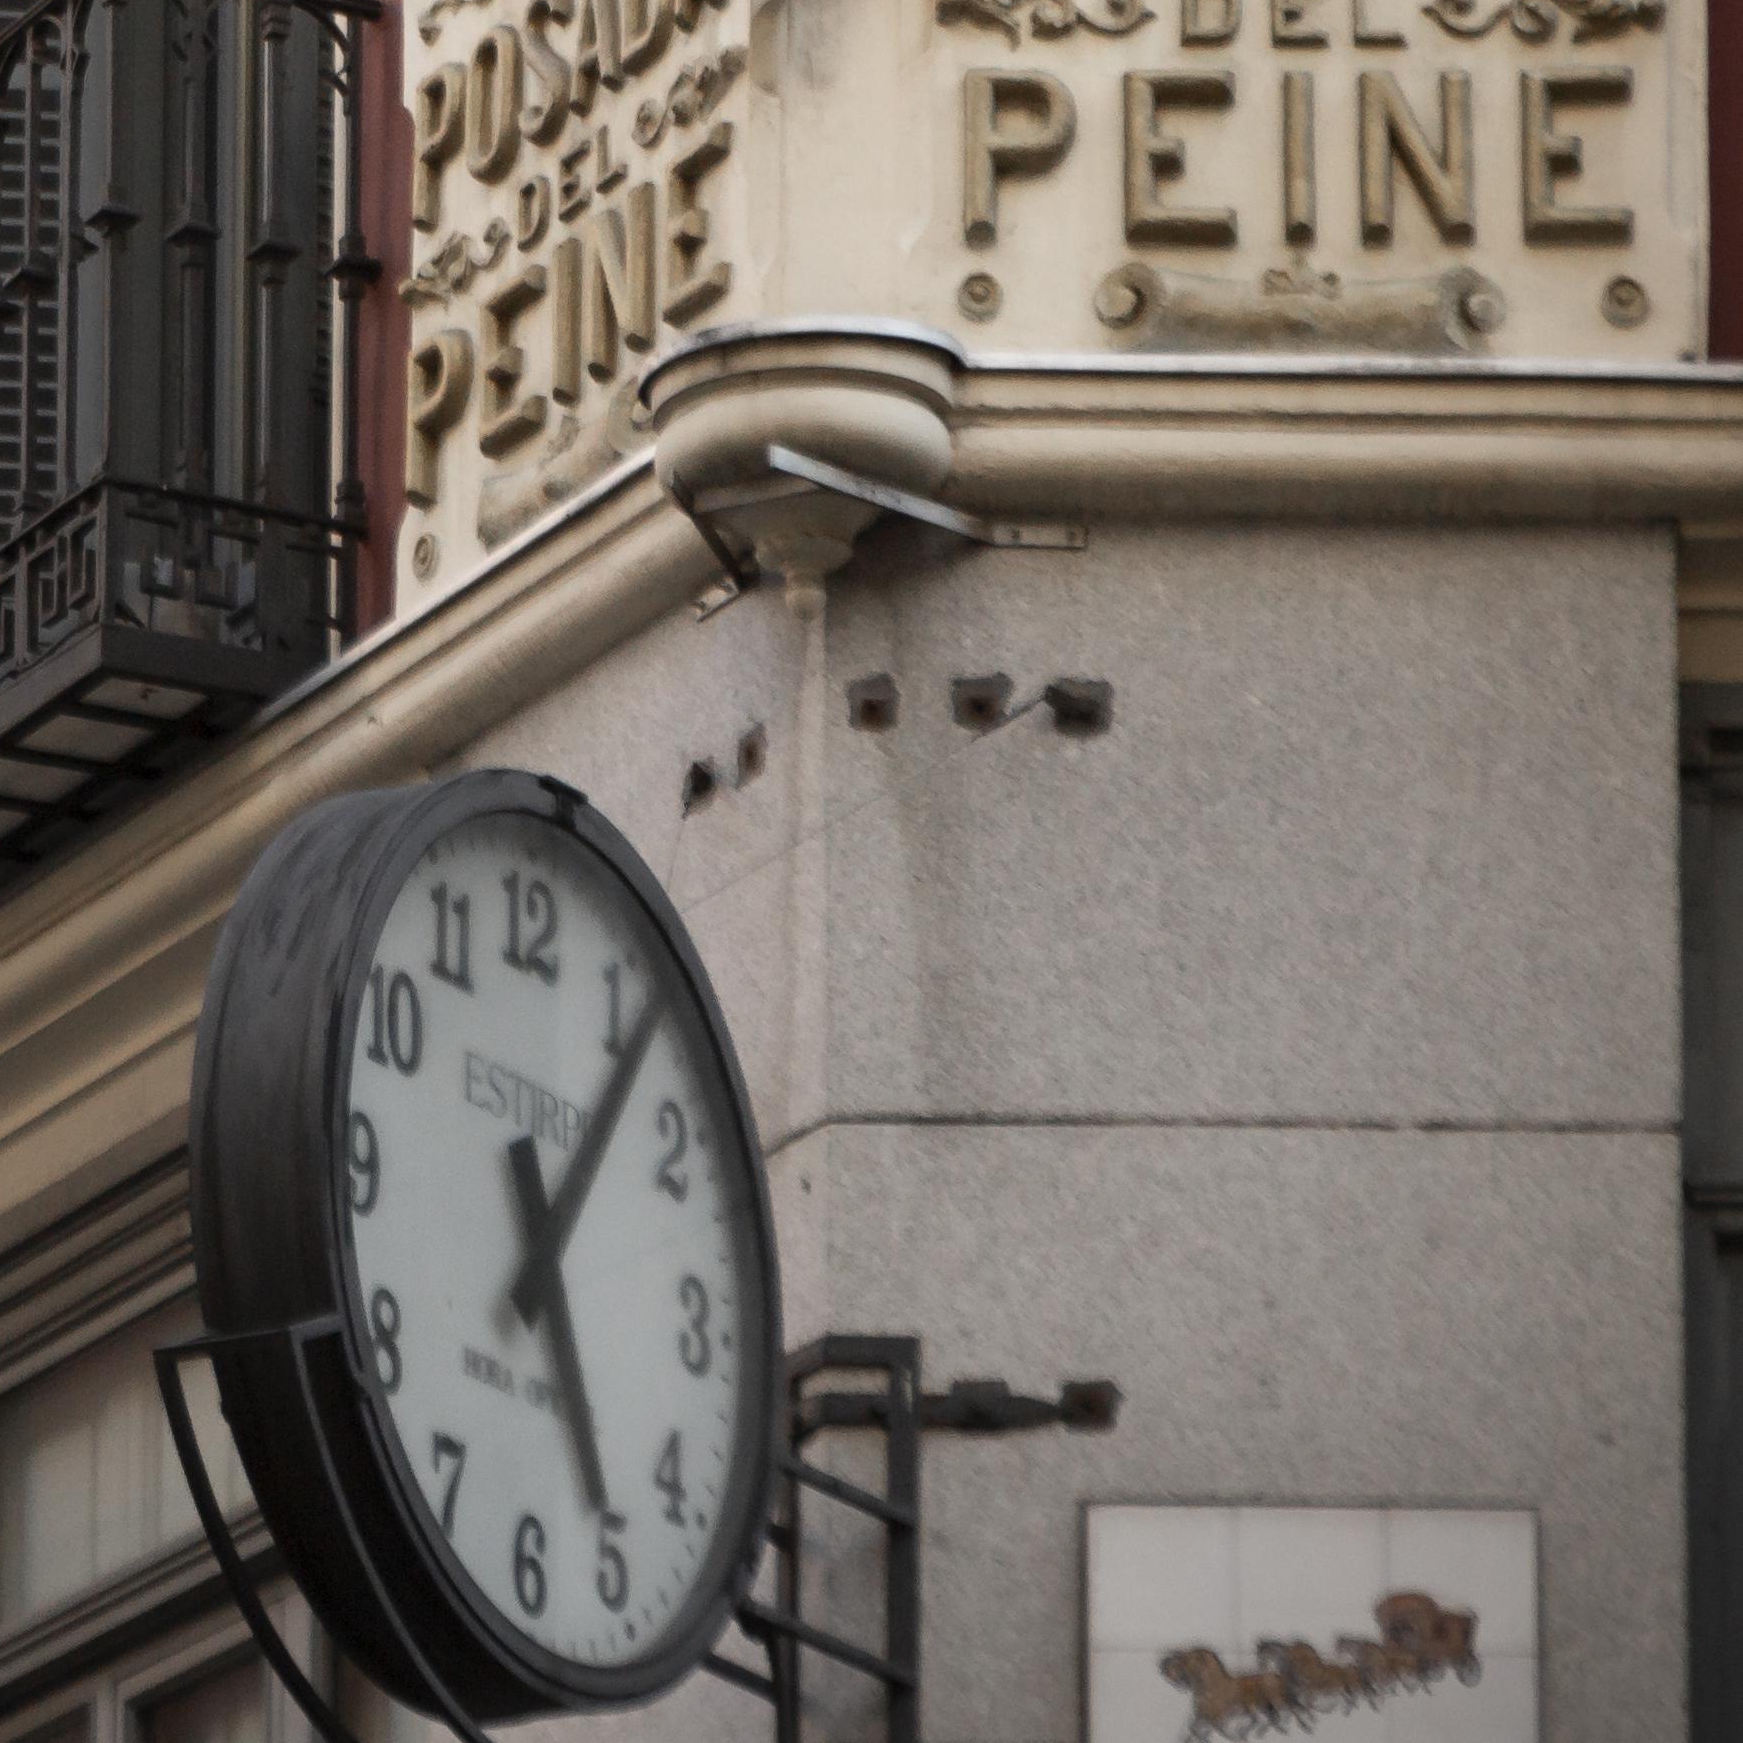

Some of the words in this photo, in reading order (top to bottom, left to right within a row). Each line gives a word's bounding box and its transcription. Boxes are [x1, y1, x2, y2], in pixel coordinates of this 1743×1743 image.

[517, 124, 628, 254] DEL
[962, 65, 1635, 251] PEINE
[404, 120, 735, 510] PEINE
[428, 879, 476, 998] 11
[502, 870, 560, 989] 12
[365, 962, 423, 1079] 10
[601, 960, 622, 1060] 1
[463, 1049, 590, 1153] ESTIRP
[654, 1099, 689, 1205] 2
[347, 1109, 381, 1219] 9
[370, 1286, 402, 1397] 8
[677, 1273, 712, 1379] 3
[431, 1430, 468, 1541] 7
[652, 1426, 687, 1530] 4
[513, 1510, 549, 1621] 6
[594, 1509, 631, 1614] 5
